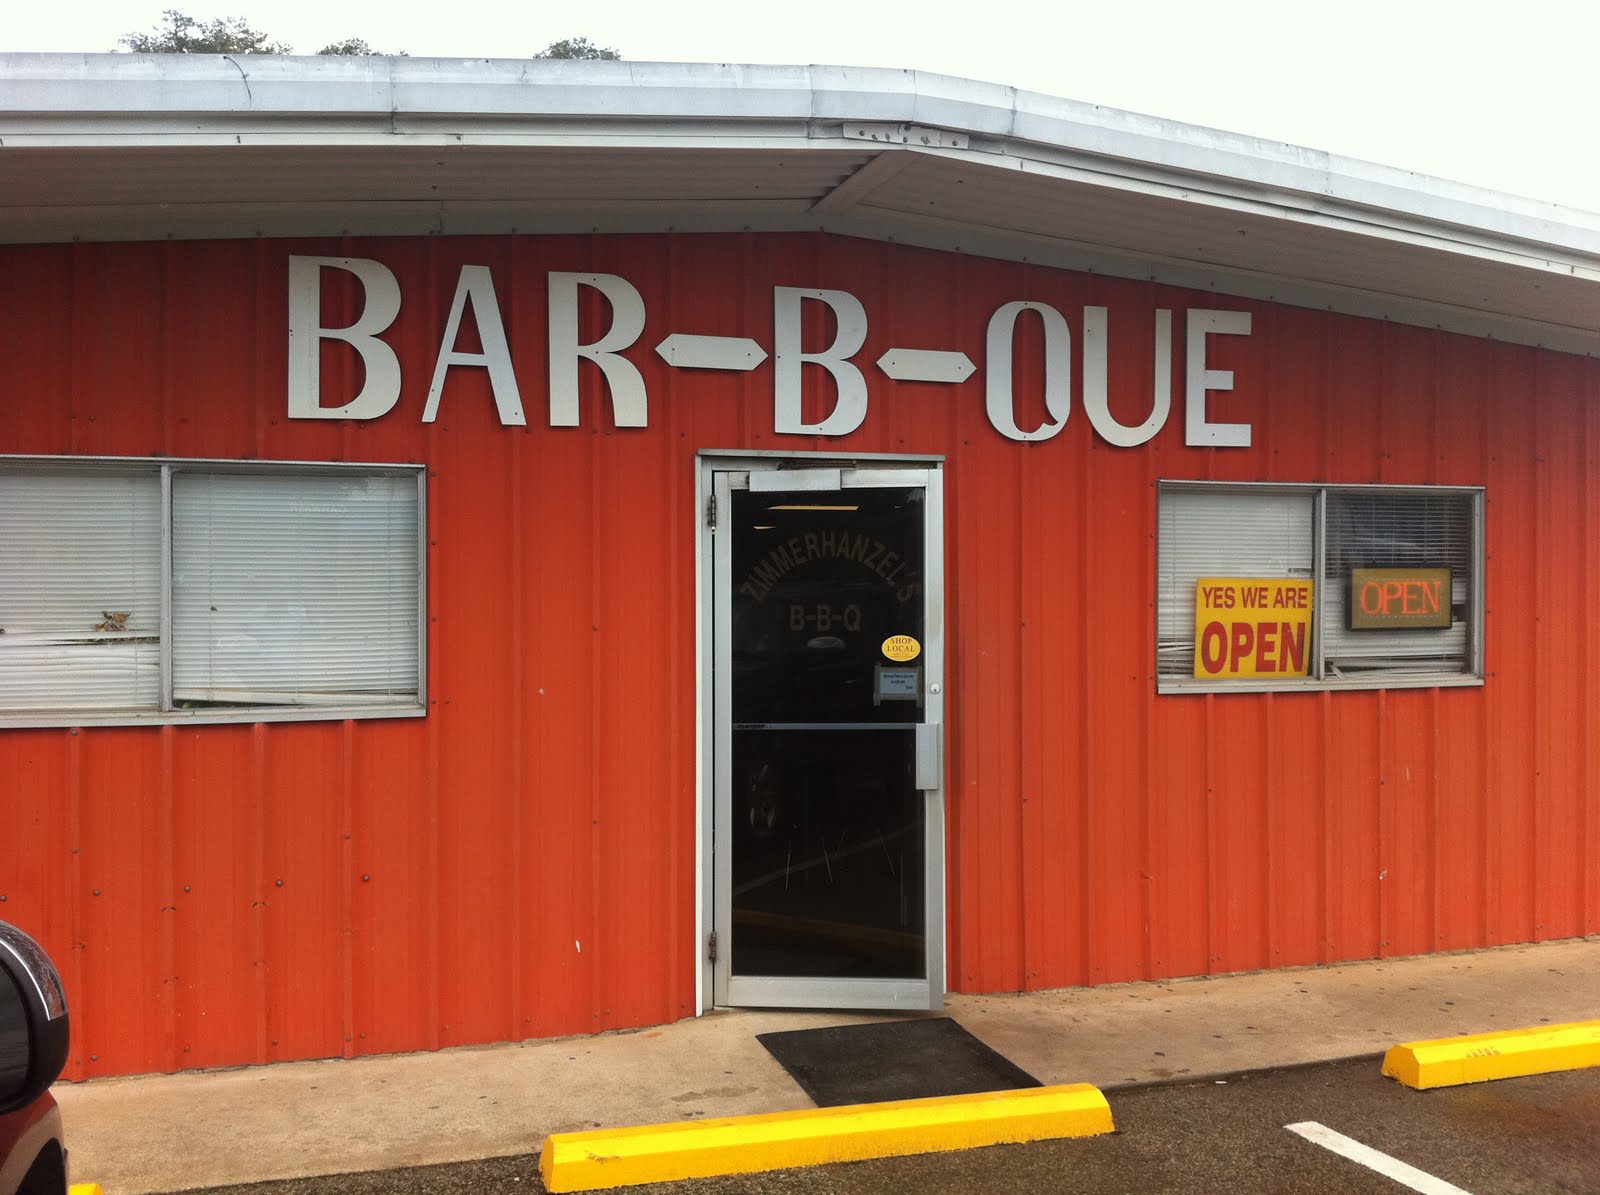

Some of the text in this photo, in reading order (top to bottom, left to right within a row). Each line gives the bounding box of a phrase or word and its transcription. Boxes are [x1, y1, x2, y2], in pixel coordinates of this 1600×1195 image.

[287, 255, 1252, 448] BAR-B-QUE
[1202, 587, 1309, 609] YES WE ARE
[1360, 580, 1442, 616] OPEN
[789, 603, 862, 632] B-B-Q
[890, 637, 913, 645] SHOP
[1201, 621, 1306, 675] OPEN
